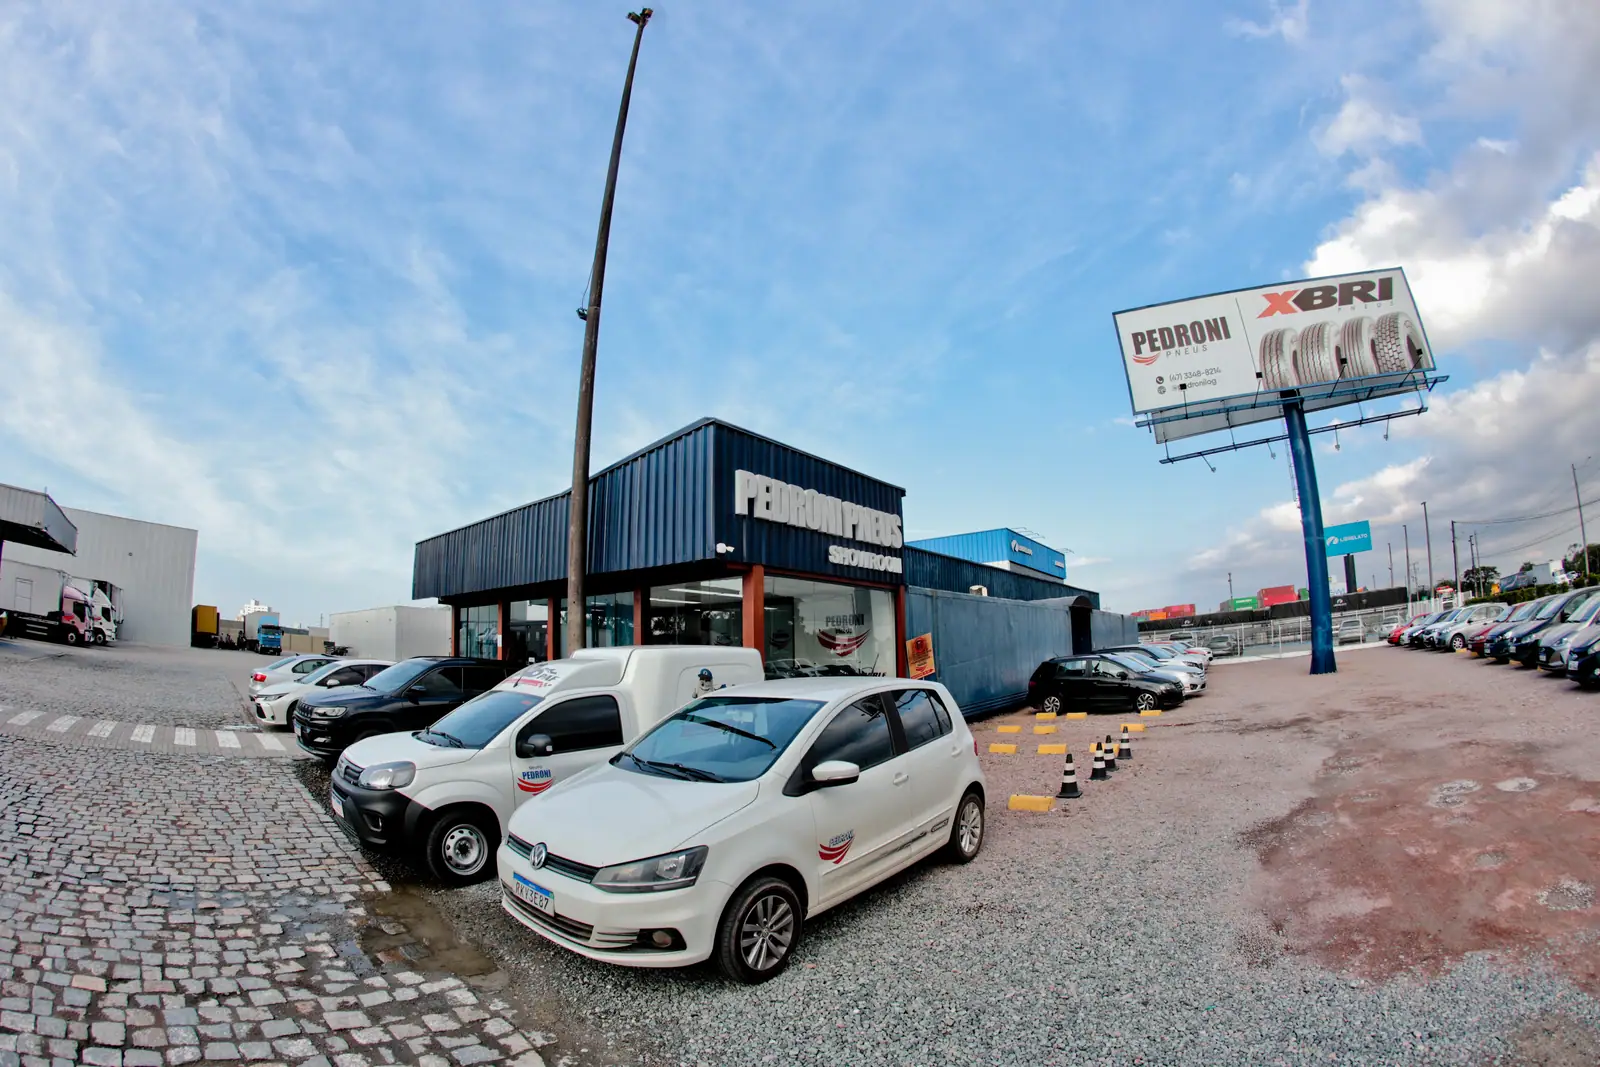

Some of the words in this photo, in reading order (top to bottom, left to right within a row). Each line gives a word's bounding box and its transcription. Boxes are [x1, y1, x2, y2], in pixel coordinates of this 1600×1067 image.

[1256, 277, 1393, 319] XBRI
[1131, 316, 1231, 355] PEDRONI
[1166, 344, 1208, 358] PNEUS
[735, 469, 843, 537] PEDRONI
[842, 501, 902, 548] PNEUS
[828, 545, 902, 574] SHOWROOM
[825, 613, 864, 627] PEDRONI
[522, 769, 552, 780] PEDRONI
